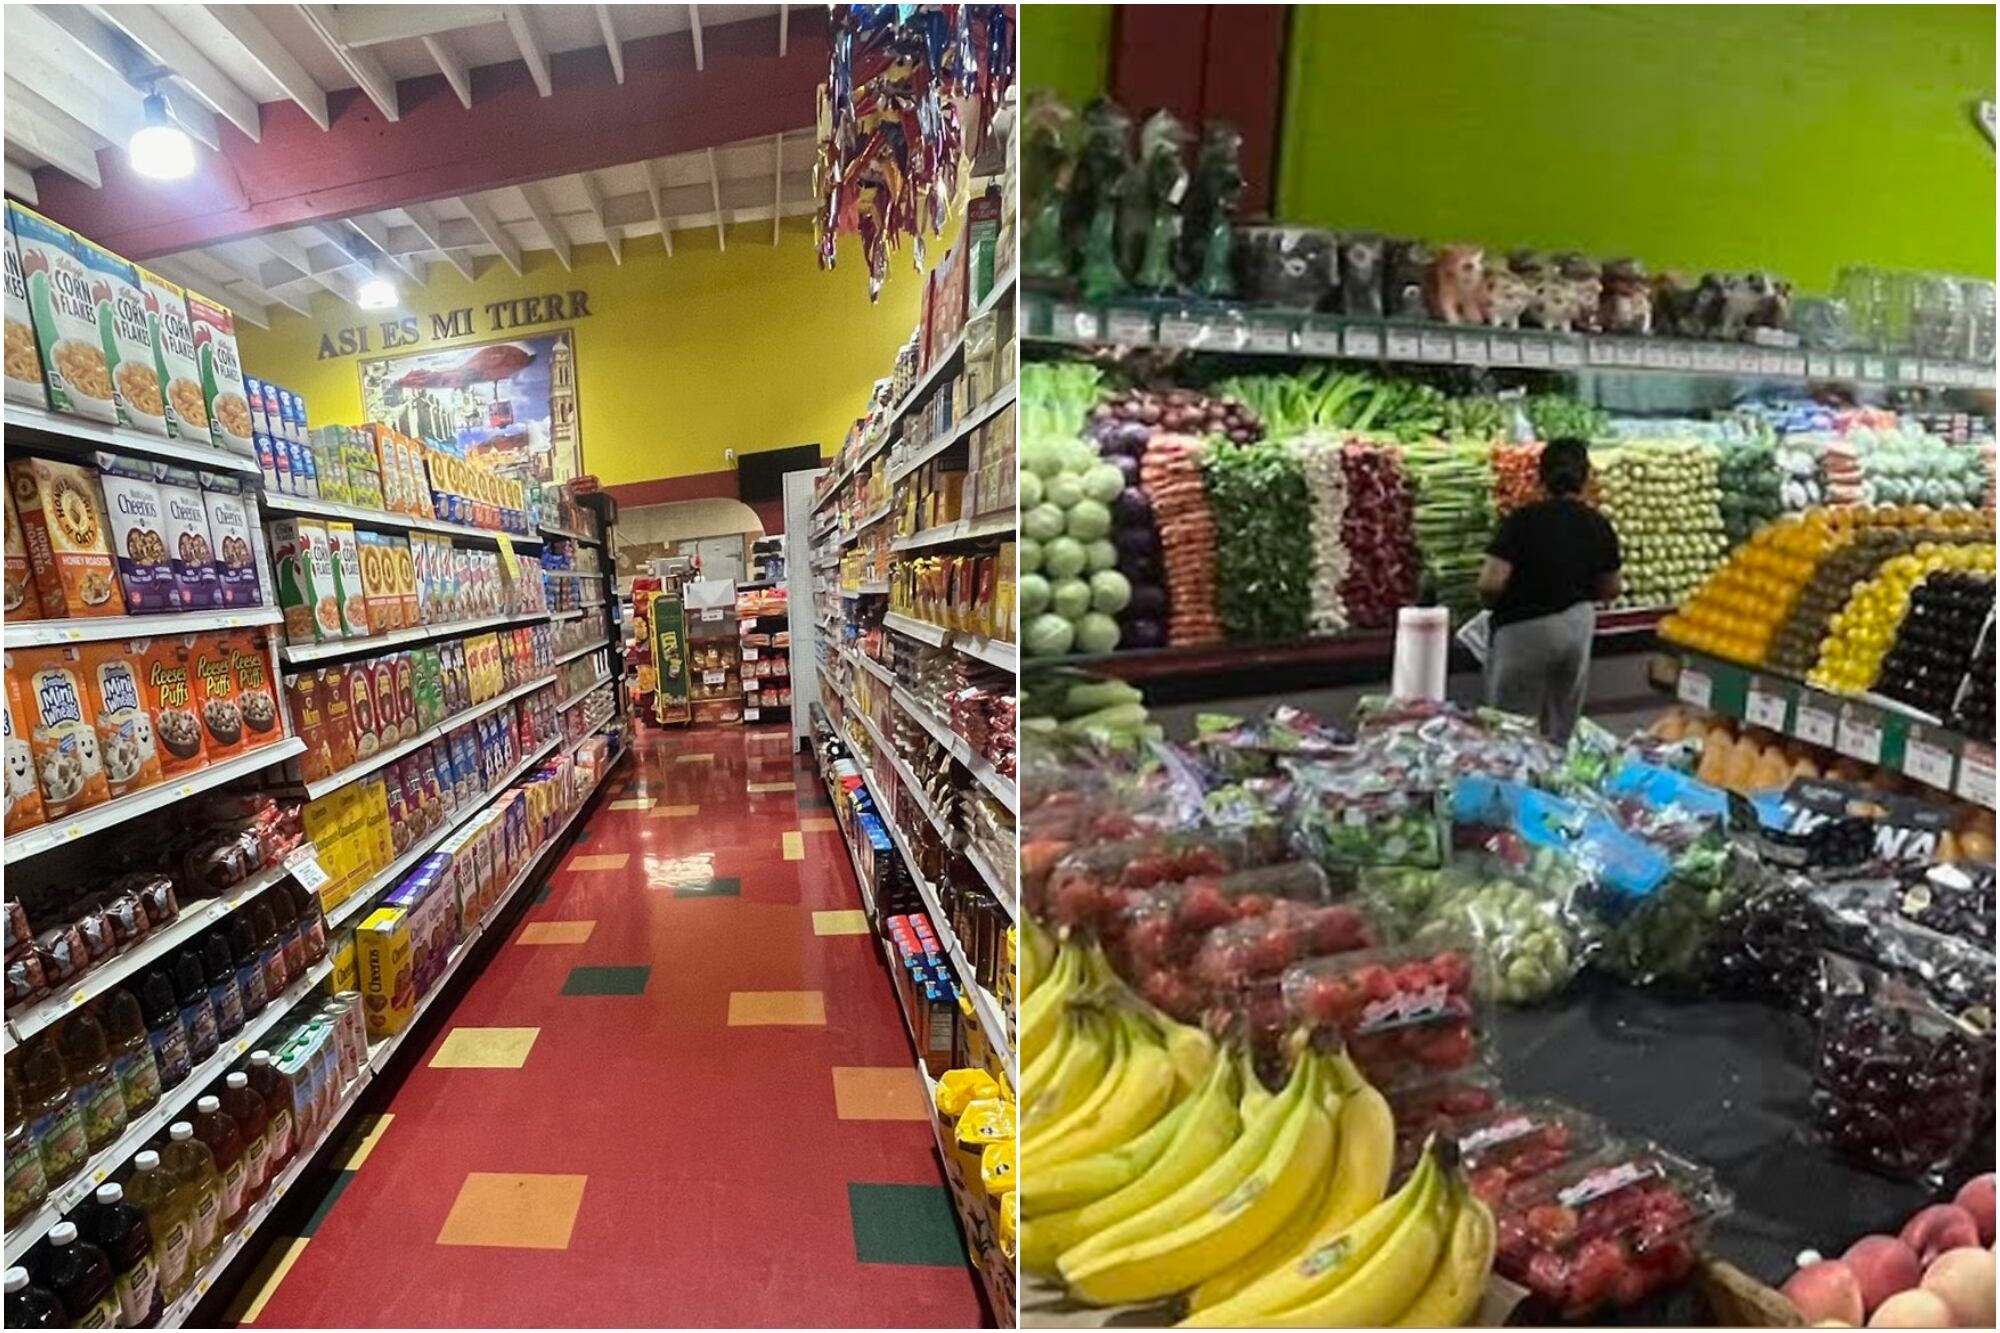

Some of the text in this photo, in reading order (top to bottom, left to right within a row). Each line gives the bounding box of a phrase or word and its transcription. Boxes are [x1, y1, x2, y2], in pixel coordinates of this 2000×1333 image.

[55, 270, 92, 305] CORN
[60, 294, 97, 326] FLAKES
[118, 298, 147, 328] CORN
[121, 320, 151, 348] FLAKES
[165, 314, 193, 341] CORN
[318, 289, 592, 361] ASI ES MI TIERR
[217, 347, 237, 370] CORN
[117, 493, 157, 518] Cheerios
[170, 500, 203, 522] Cheerios
[26, 522, 45, 575] ROASTED
[36, 527, 53, 565] HONEY
[41, 683, 75, 710] Mini
[104, 674, 133, 700] Mini
[160, 683, 189, 709] Puffs
[206, 674, 231, 699] Puffs
[43, 700, 80, 728] Wheats
